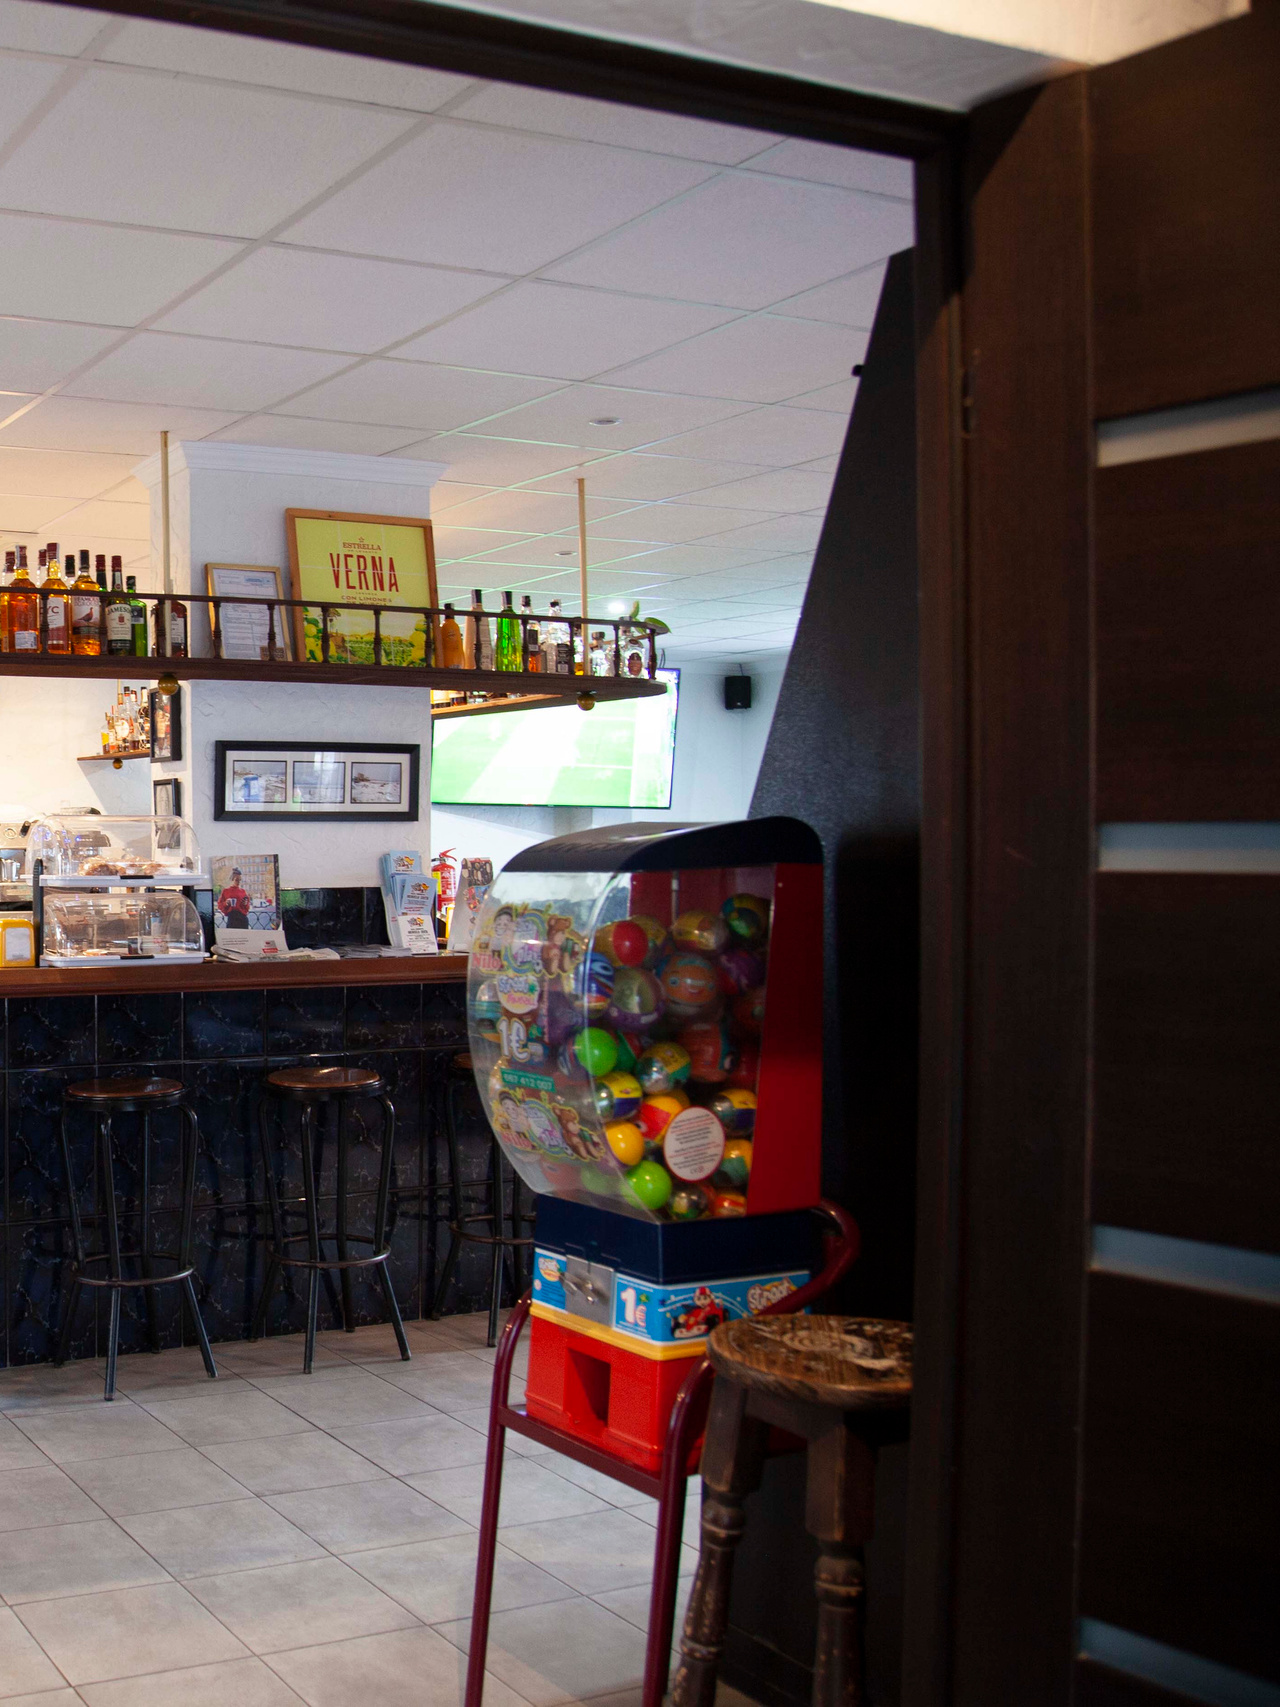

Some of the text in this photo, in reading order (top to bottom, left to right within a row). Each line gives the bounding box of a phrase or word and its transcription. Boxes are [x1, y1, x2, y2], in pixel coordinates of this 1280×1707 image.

[342, 542, 382, 551] ESTRELLA
[329, 552, 399, 593] VERNA
[620, 1287, 647, 1328] 1€
